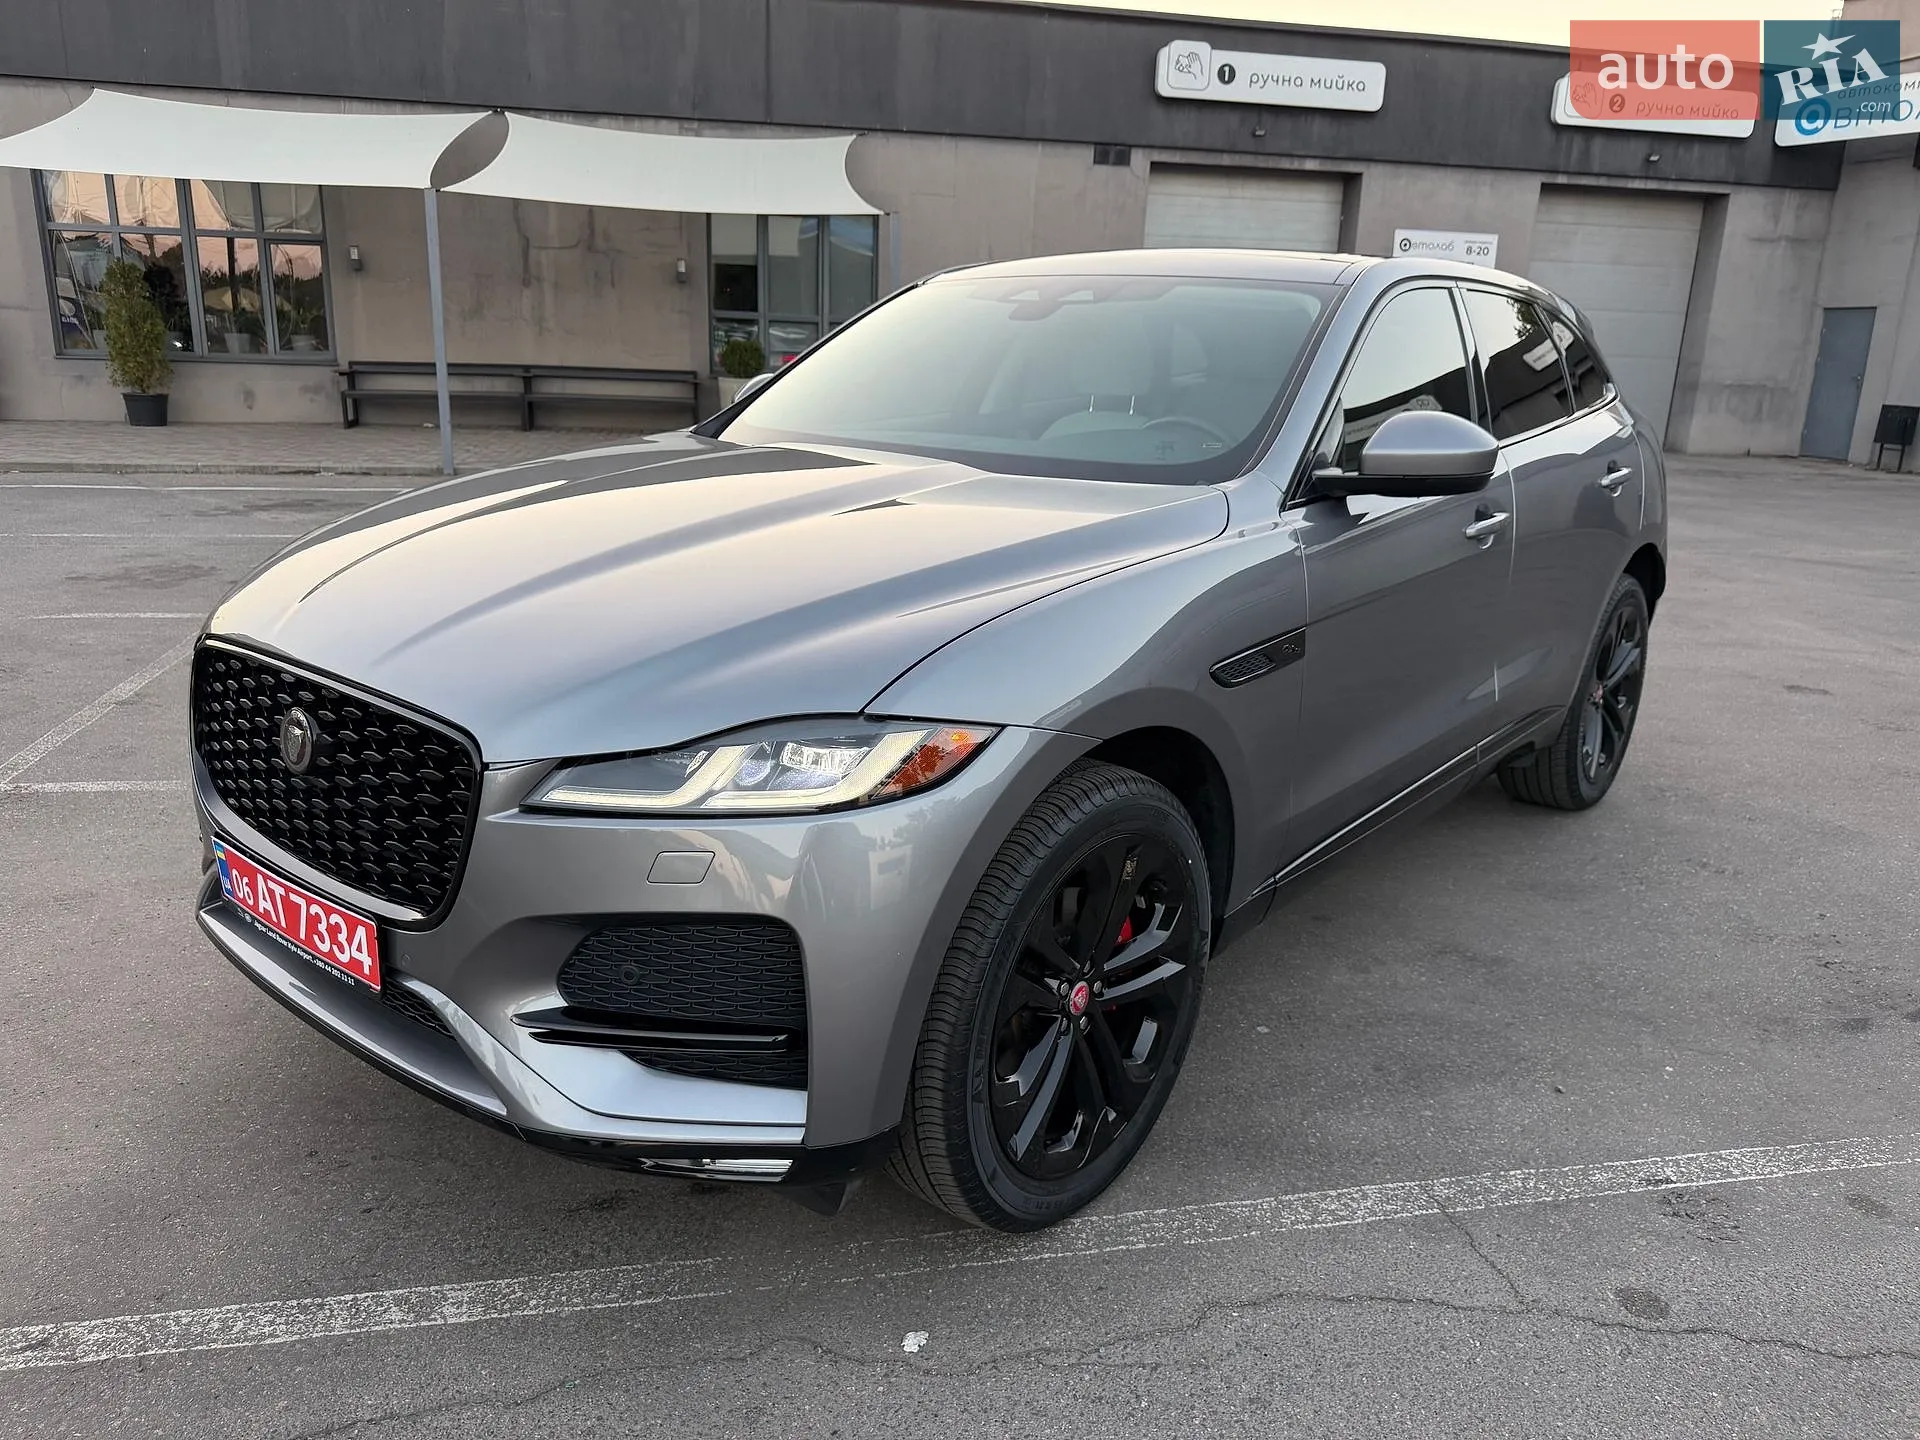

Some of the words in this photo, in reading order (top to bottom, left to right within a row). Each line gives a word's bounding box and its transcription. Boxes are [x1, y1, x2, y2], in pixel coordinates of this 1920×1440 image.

[1249, 70, 1303, 89] ручна
[1309, 74, 1366, 92] мийка
[1635, 100, 1685, 116] ручна
[1689, 104, 1739, 120] мийка
